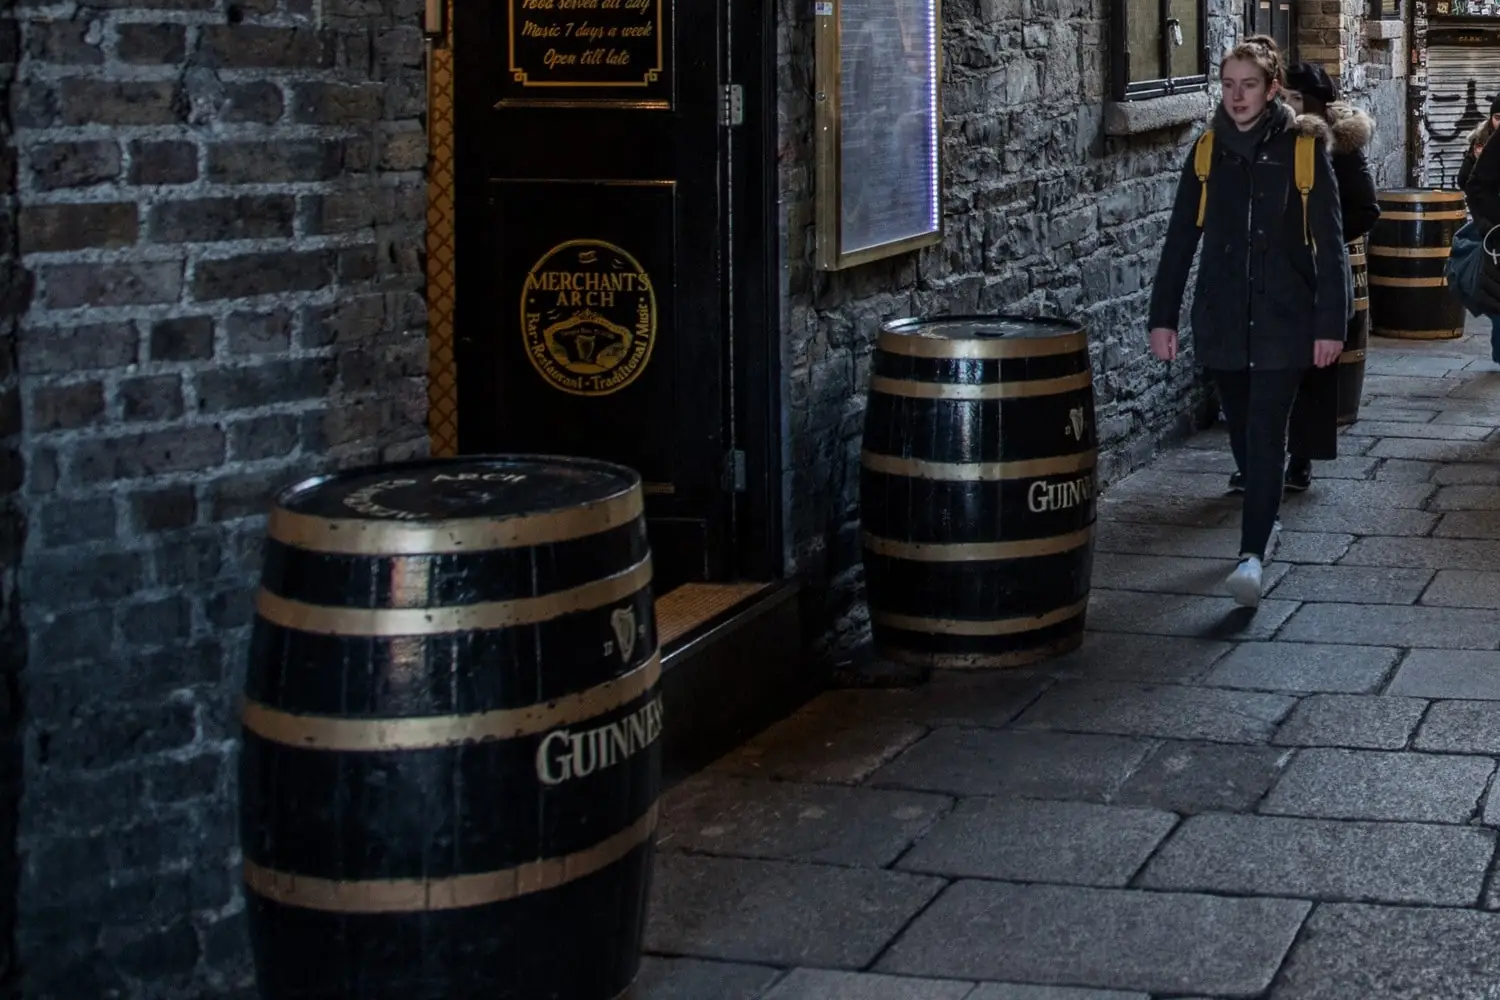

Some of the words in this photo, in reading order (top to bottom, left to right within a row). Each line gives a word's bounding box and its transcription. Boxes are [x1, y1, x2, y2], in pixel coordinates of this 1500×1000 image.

[521, 20, 561, 37] Music
[563, 22, 574, 37] 7
[575, 20, 604, 43] days
[607, 28, 618, 37] a
[621, 20, 653, 37] week
[543, 48, 577, 70] Open
[579, 48, 606, 65] till
[606, 48, 631, 65] late
[556, 291, 616, 308] ARCH
[527, 312, 540, 339] Bar
[634, 303, 650, 338] Music
[530, 344, 584, 389] Restaurant
